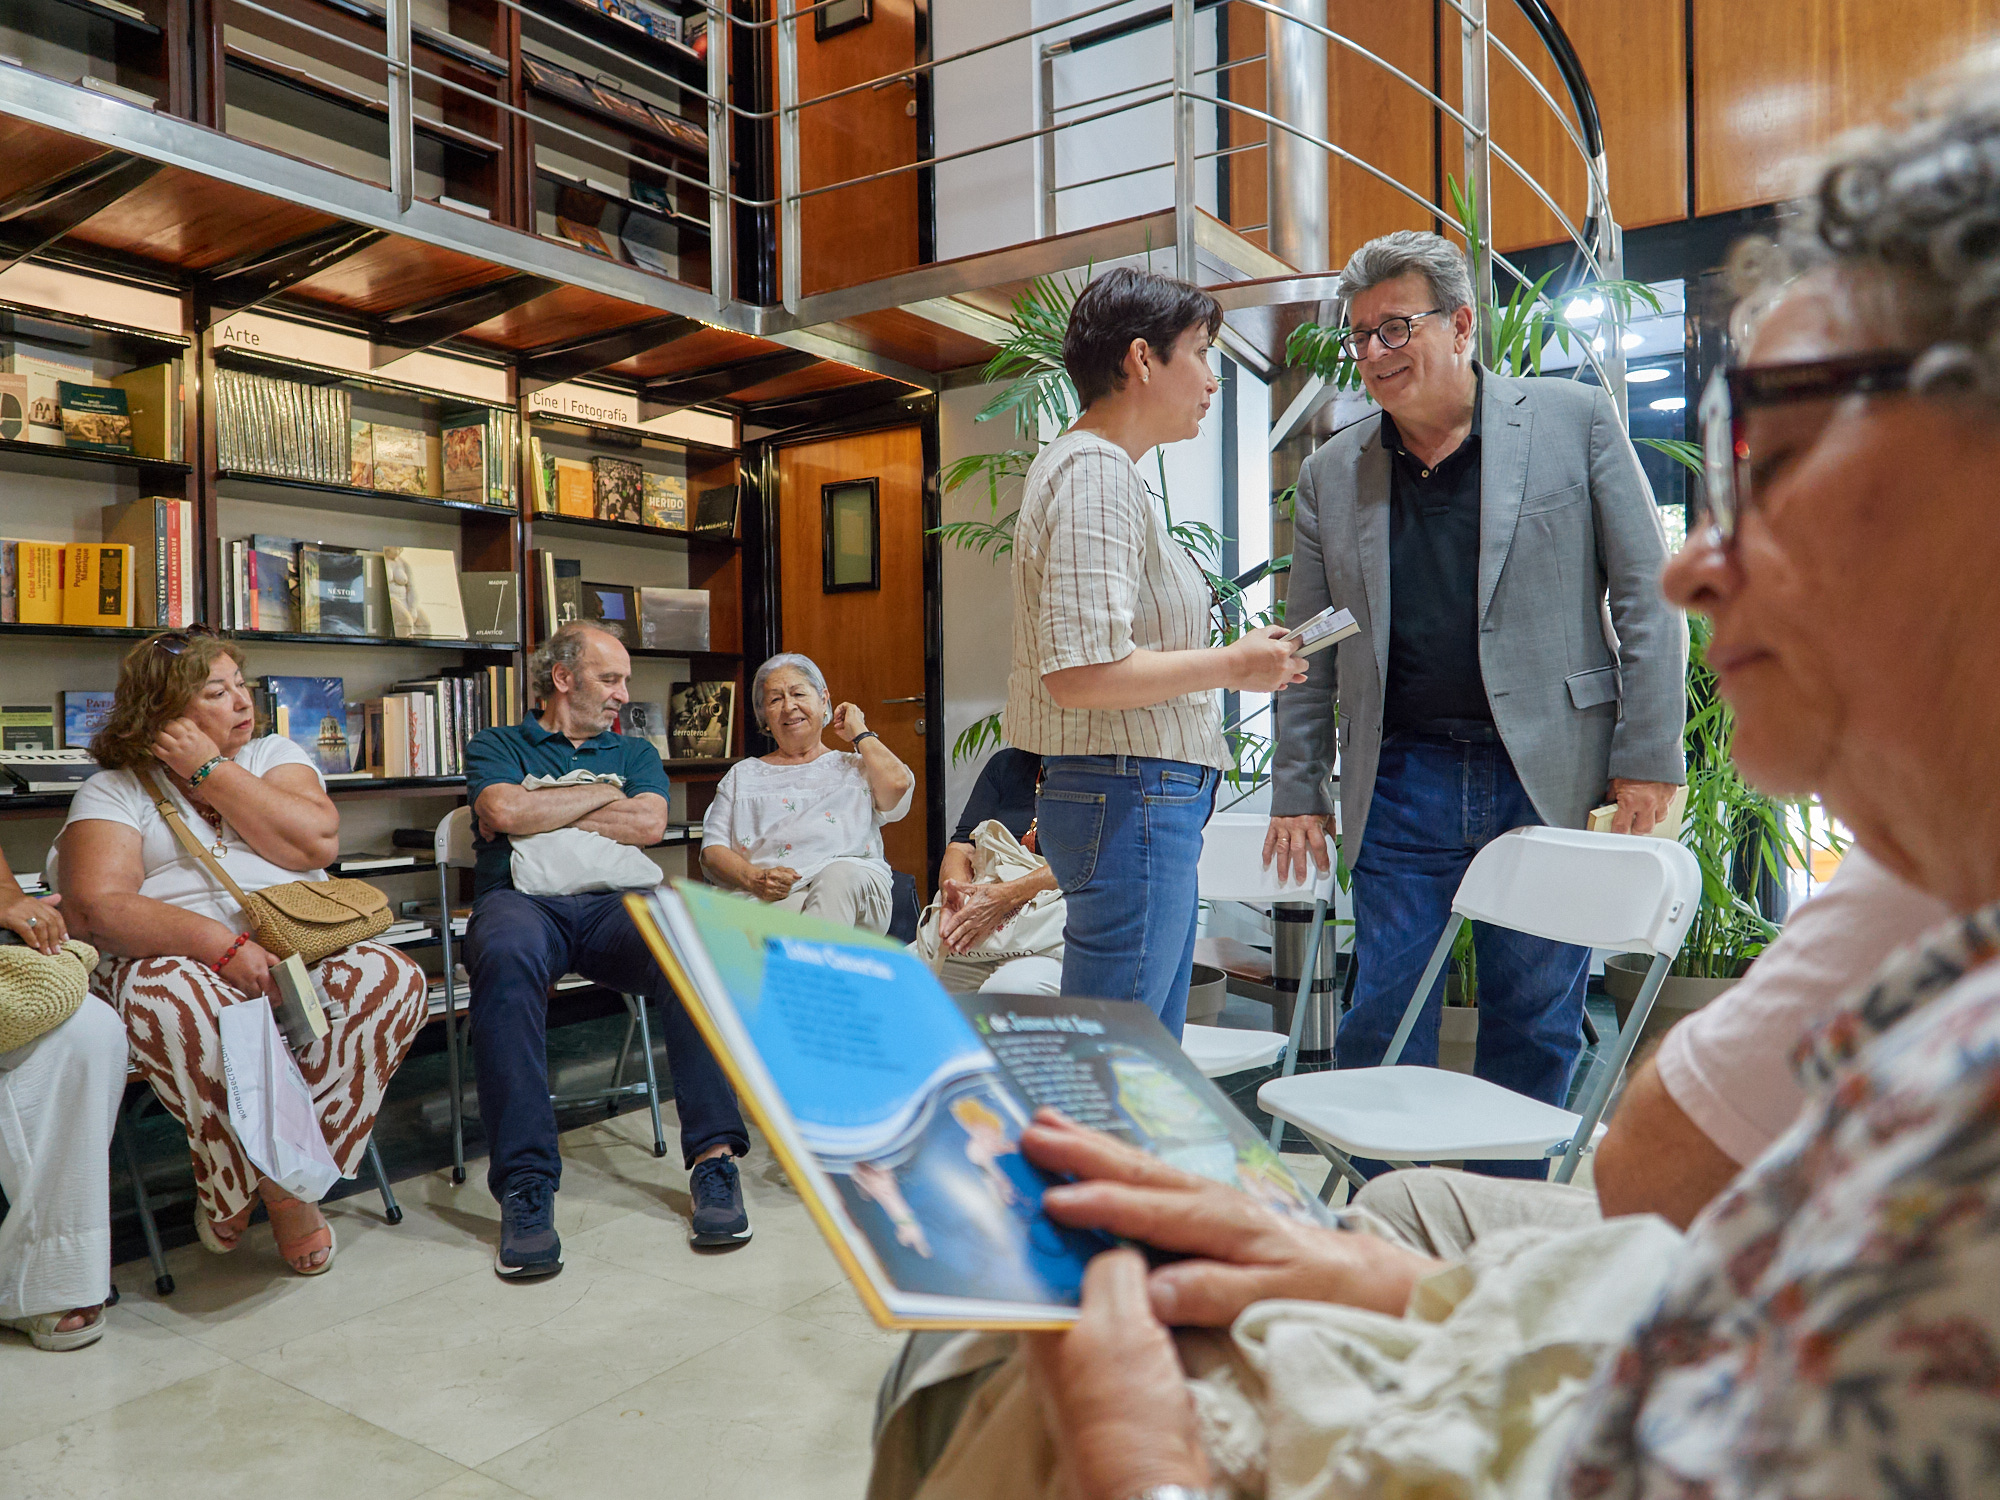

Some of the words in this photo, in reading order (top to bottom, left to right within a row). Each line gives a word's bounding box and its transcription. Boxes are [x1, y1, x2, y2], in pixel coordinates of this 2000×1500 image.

[223, 324, 260, 346] Arte
[533, 392, 558, 408] Cine
[571, 400, 627, 422] Fotografía
[648, 496, 684, 509] HERIDO
[73, 548, 82, 588] Perspectiva
[80, 548, 90, 581] Manrique
[27, 580, 36, 599] César
[327, 586, 356, 597] NÉSTOR
[673, 729, 708, 737] derroteros
[221, 1044, 247, 1120] womensecret.com
